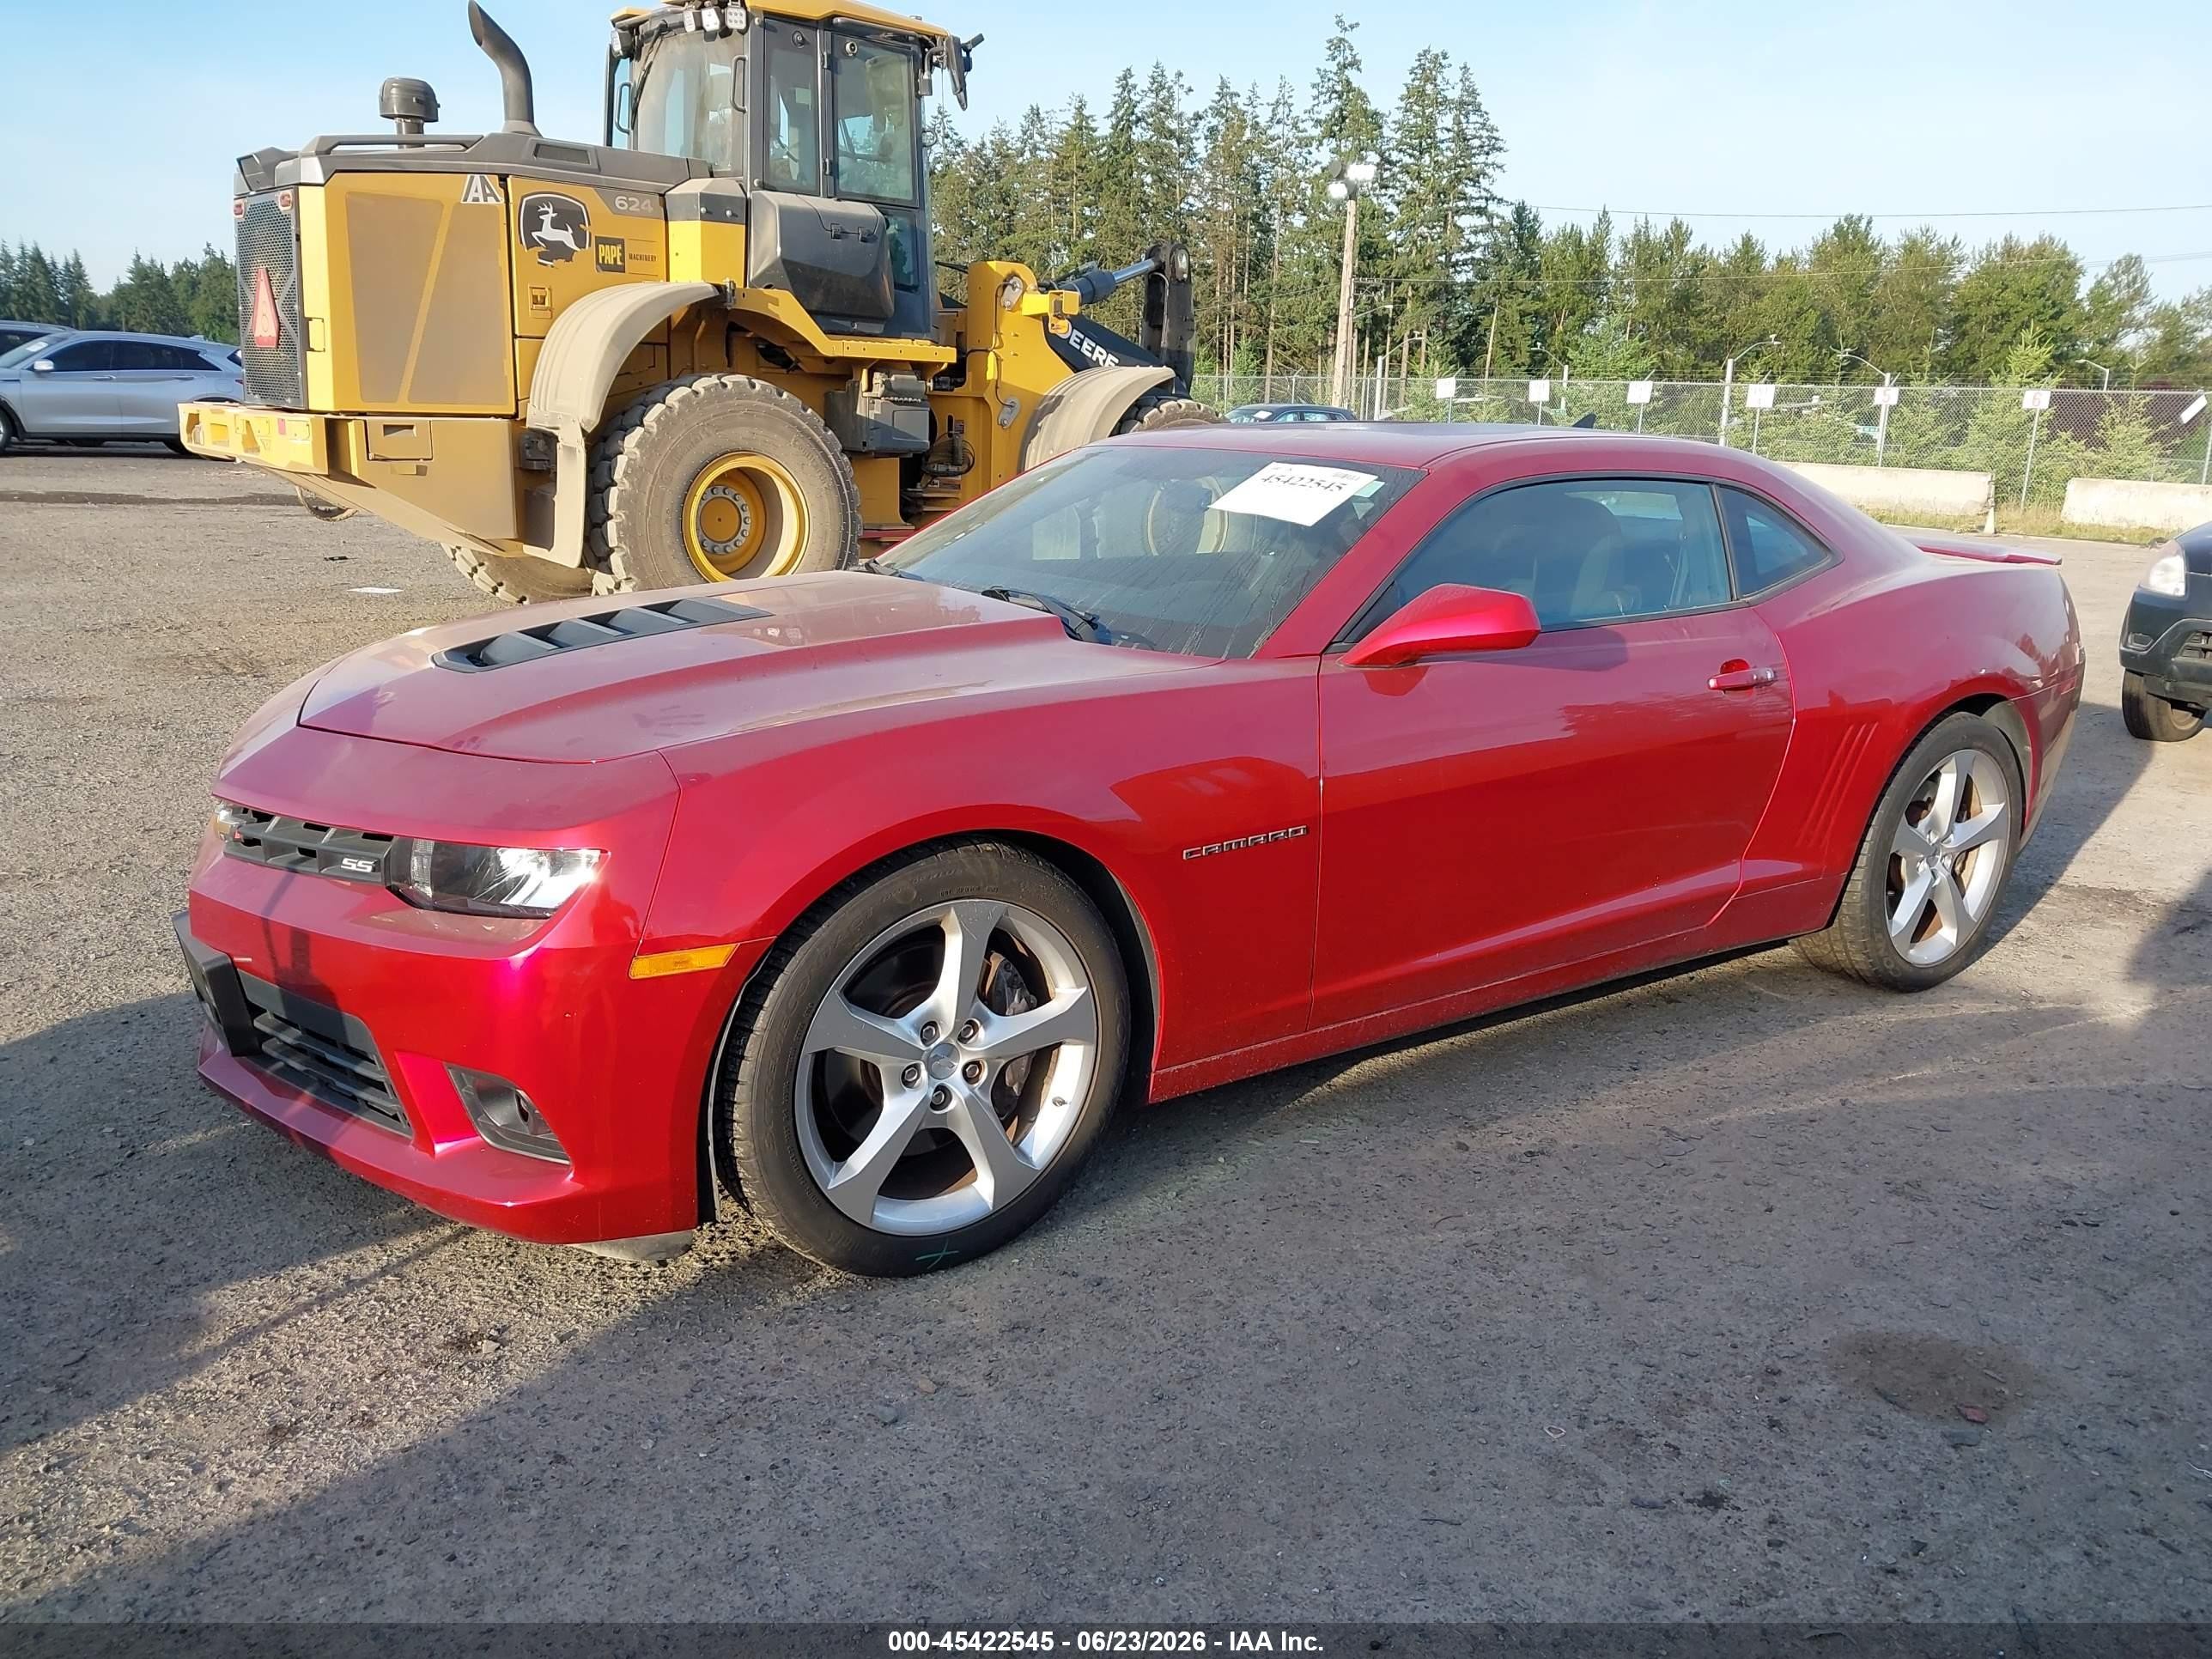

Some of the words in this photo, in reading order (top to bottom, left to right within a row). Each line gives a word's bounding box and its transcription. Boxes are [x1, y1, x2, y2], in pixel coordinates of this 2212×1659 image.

[615, 195, 653, 213] 624
[1882, 388, 1892, 403] 5
[2032, 392, 2042, 406] 6
[1261, 473, 1348, 492] 45422545
[1183, 825, 1307, 860] CAMARO
[341, 857, 374, 872] SS
